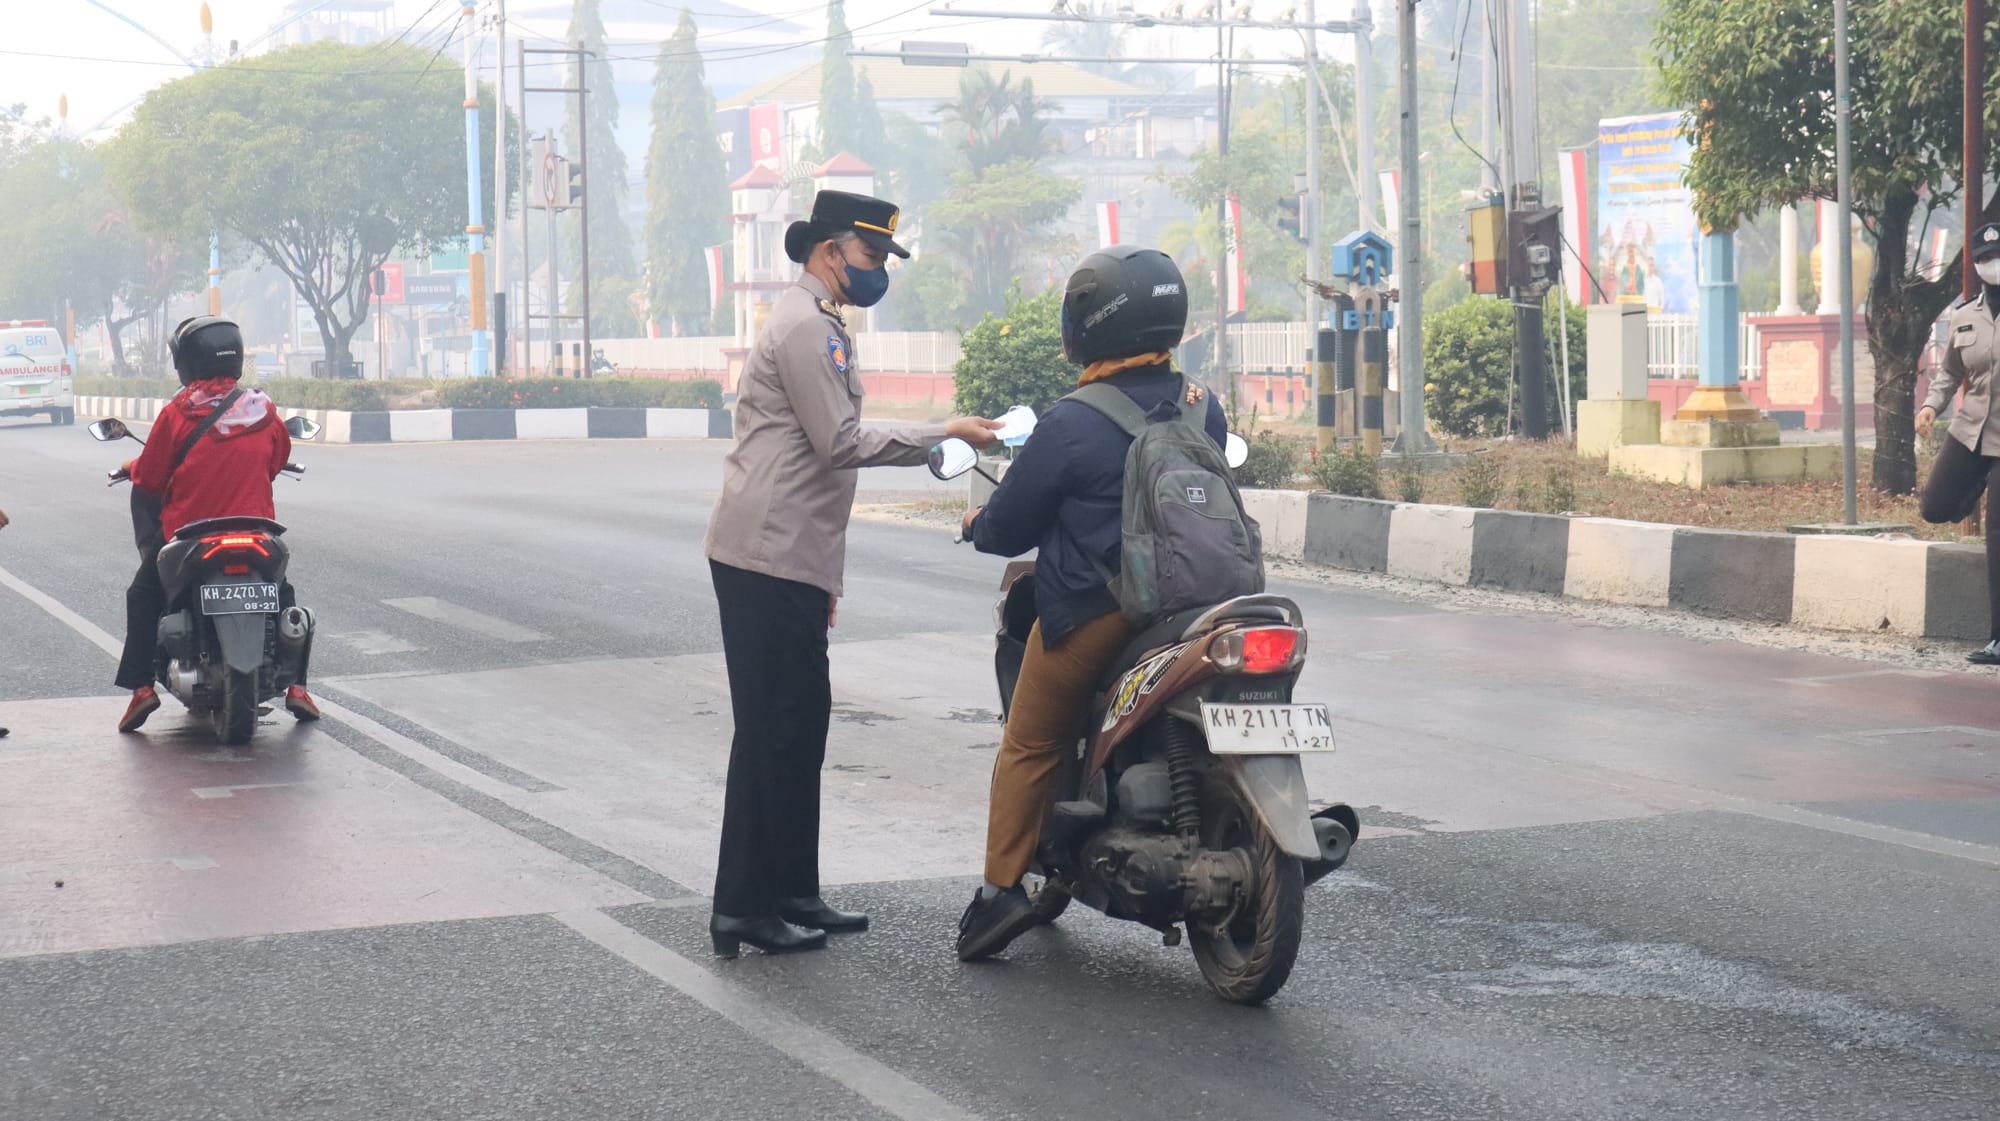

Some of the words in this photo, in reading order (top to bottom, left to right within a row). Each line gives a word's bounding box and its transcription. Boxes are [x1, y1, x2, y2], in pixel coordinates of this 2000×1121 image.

[410, 285, 451, 294] SAMSUNG
[25, 333, 48, 346] BRI
[0, 365, 60, 375] AMBULANCE
[204, 587, 219, 600] KH
[225, 586, 255, 600] 2470
[260, 585, 276, 598] YR
[1239, 691, 1278, 701] SUZUKI
[1210, 708, 1237, 727] KH
[1242, 709, 1292, 728] 2117
[1303, 708, 1331, 727] TN
